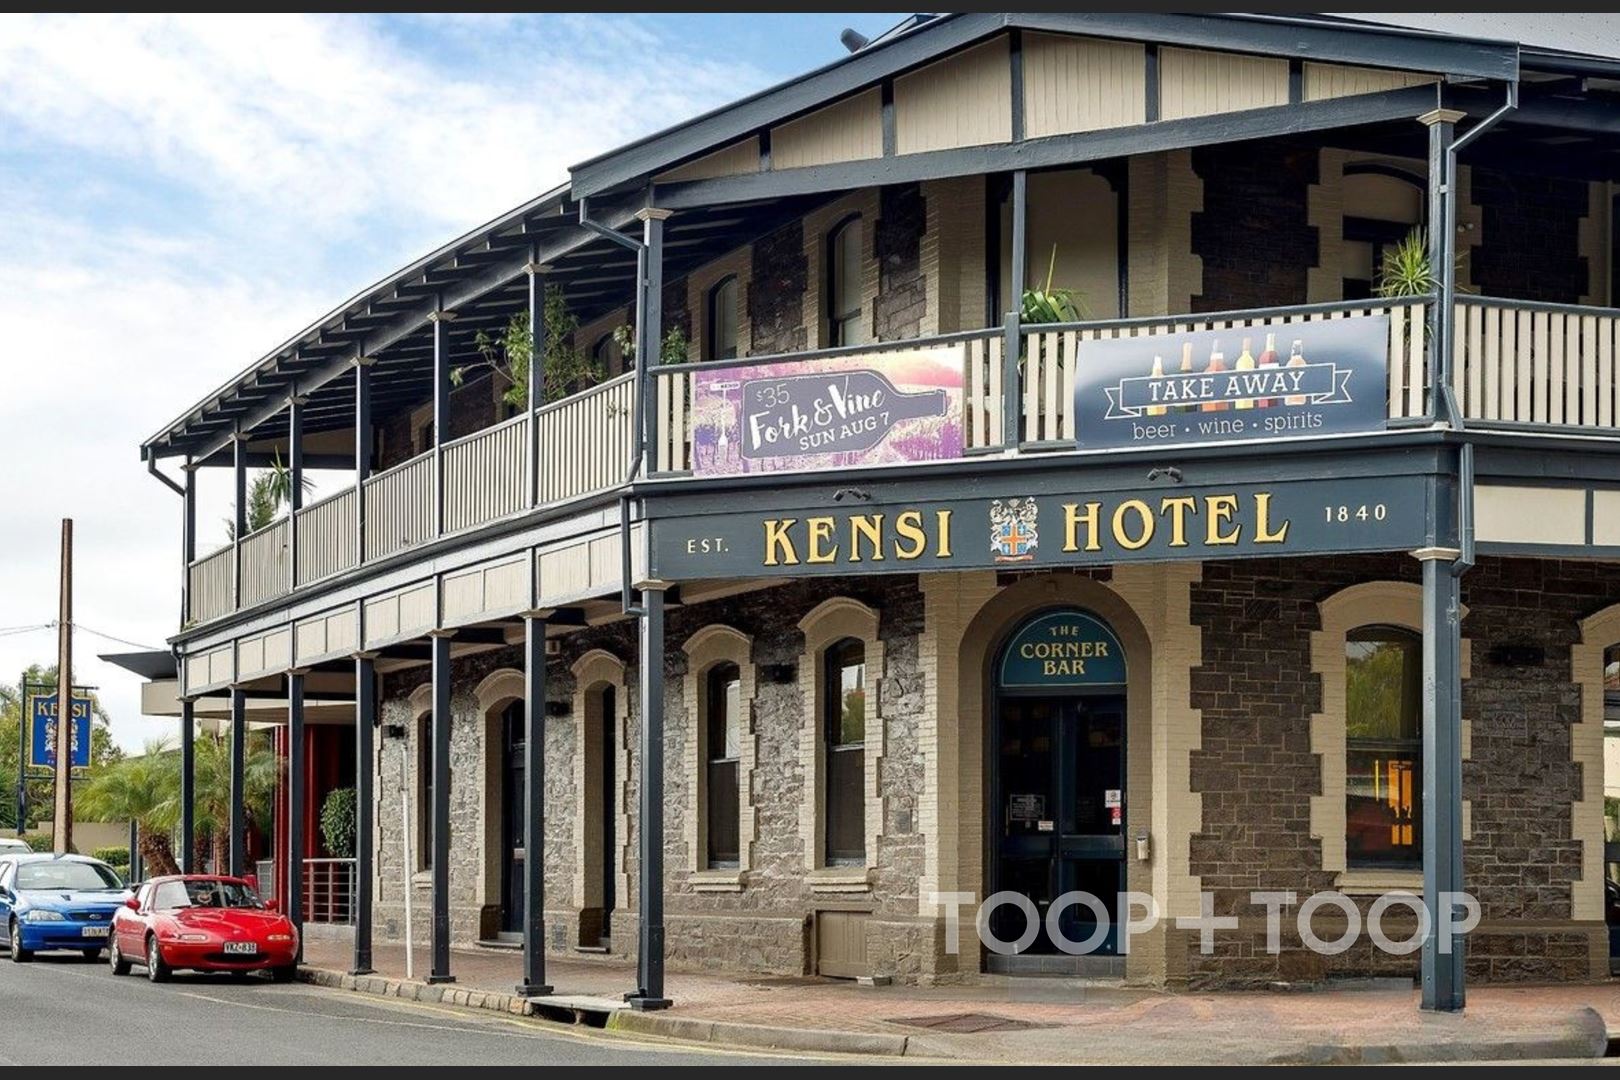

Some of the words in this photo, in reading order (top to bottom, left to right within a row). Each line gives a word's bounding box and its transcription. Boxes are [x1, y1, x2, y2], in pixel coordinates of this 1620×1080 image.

[756, 383, 790, 409] $35
[1148, 378, 1215, 402] TAKE
[1224, 370, 1306, 396] AWAY
[748, 404, 813, 450] Fork
[813, 397, 833, 425] &
[828, 375, 887, 418] Vine
[1132, 423, 1177, 440] beer
[1198, 416, 1244, 434] wine
[1264, 411, 1323, 433] spirits
[799, 432, 836, 451] SUN
[839, 421, 877, 440] AUG
[880, 412, 889, 426] 7
[687, 538, 729, 554] EST.
[763, 510, 952, 566] KENSI
[1062, 492, 1289, 552] HOTEL
[1324, 503, 1387, 523] 1840
[1049, 626, 1080, 636] THE
[1020, 642, 1109, 659] CORNER
[1043, 660, 1085, 675] BAR
[37, 702, 87, 717] KESI
